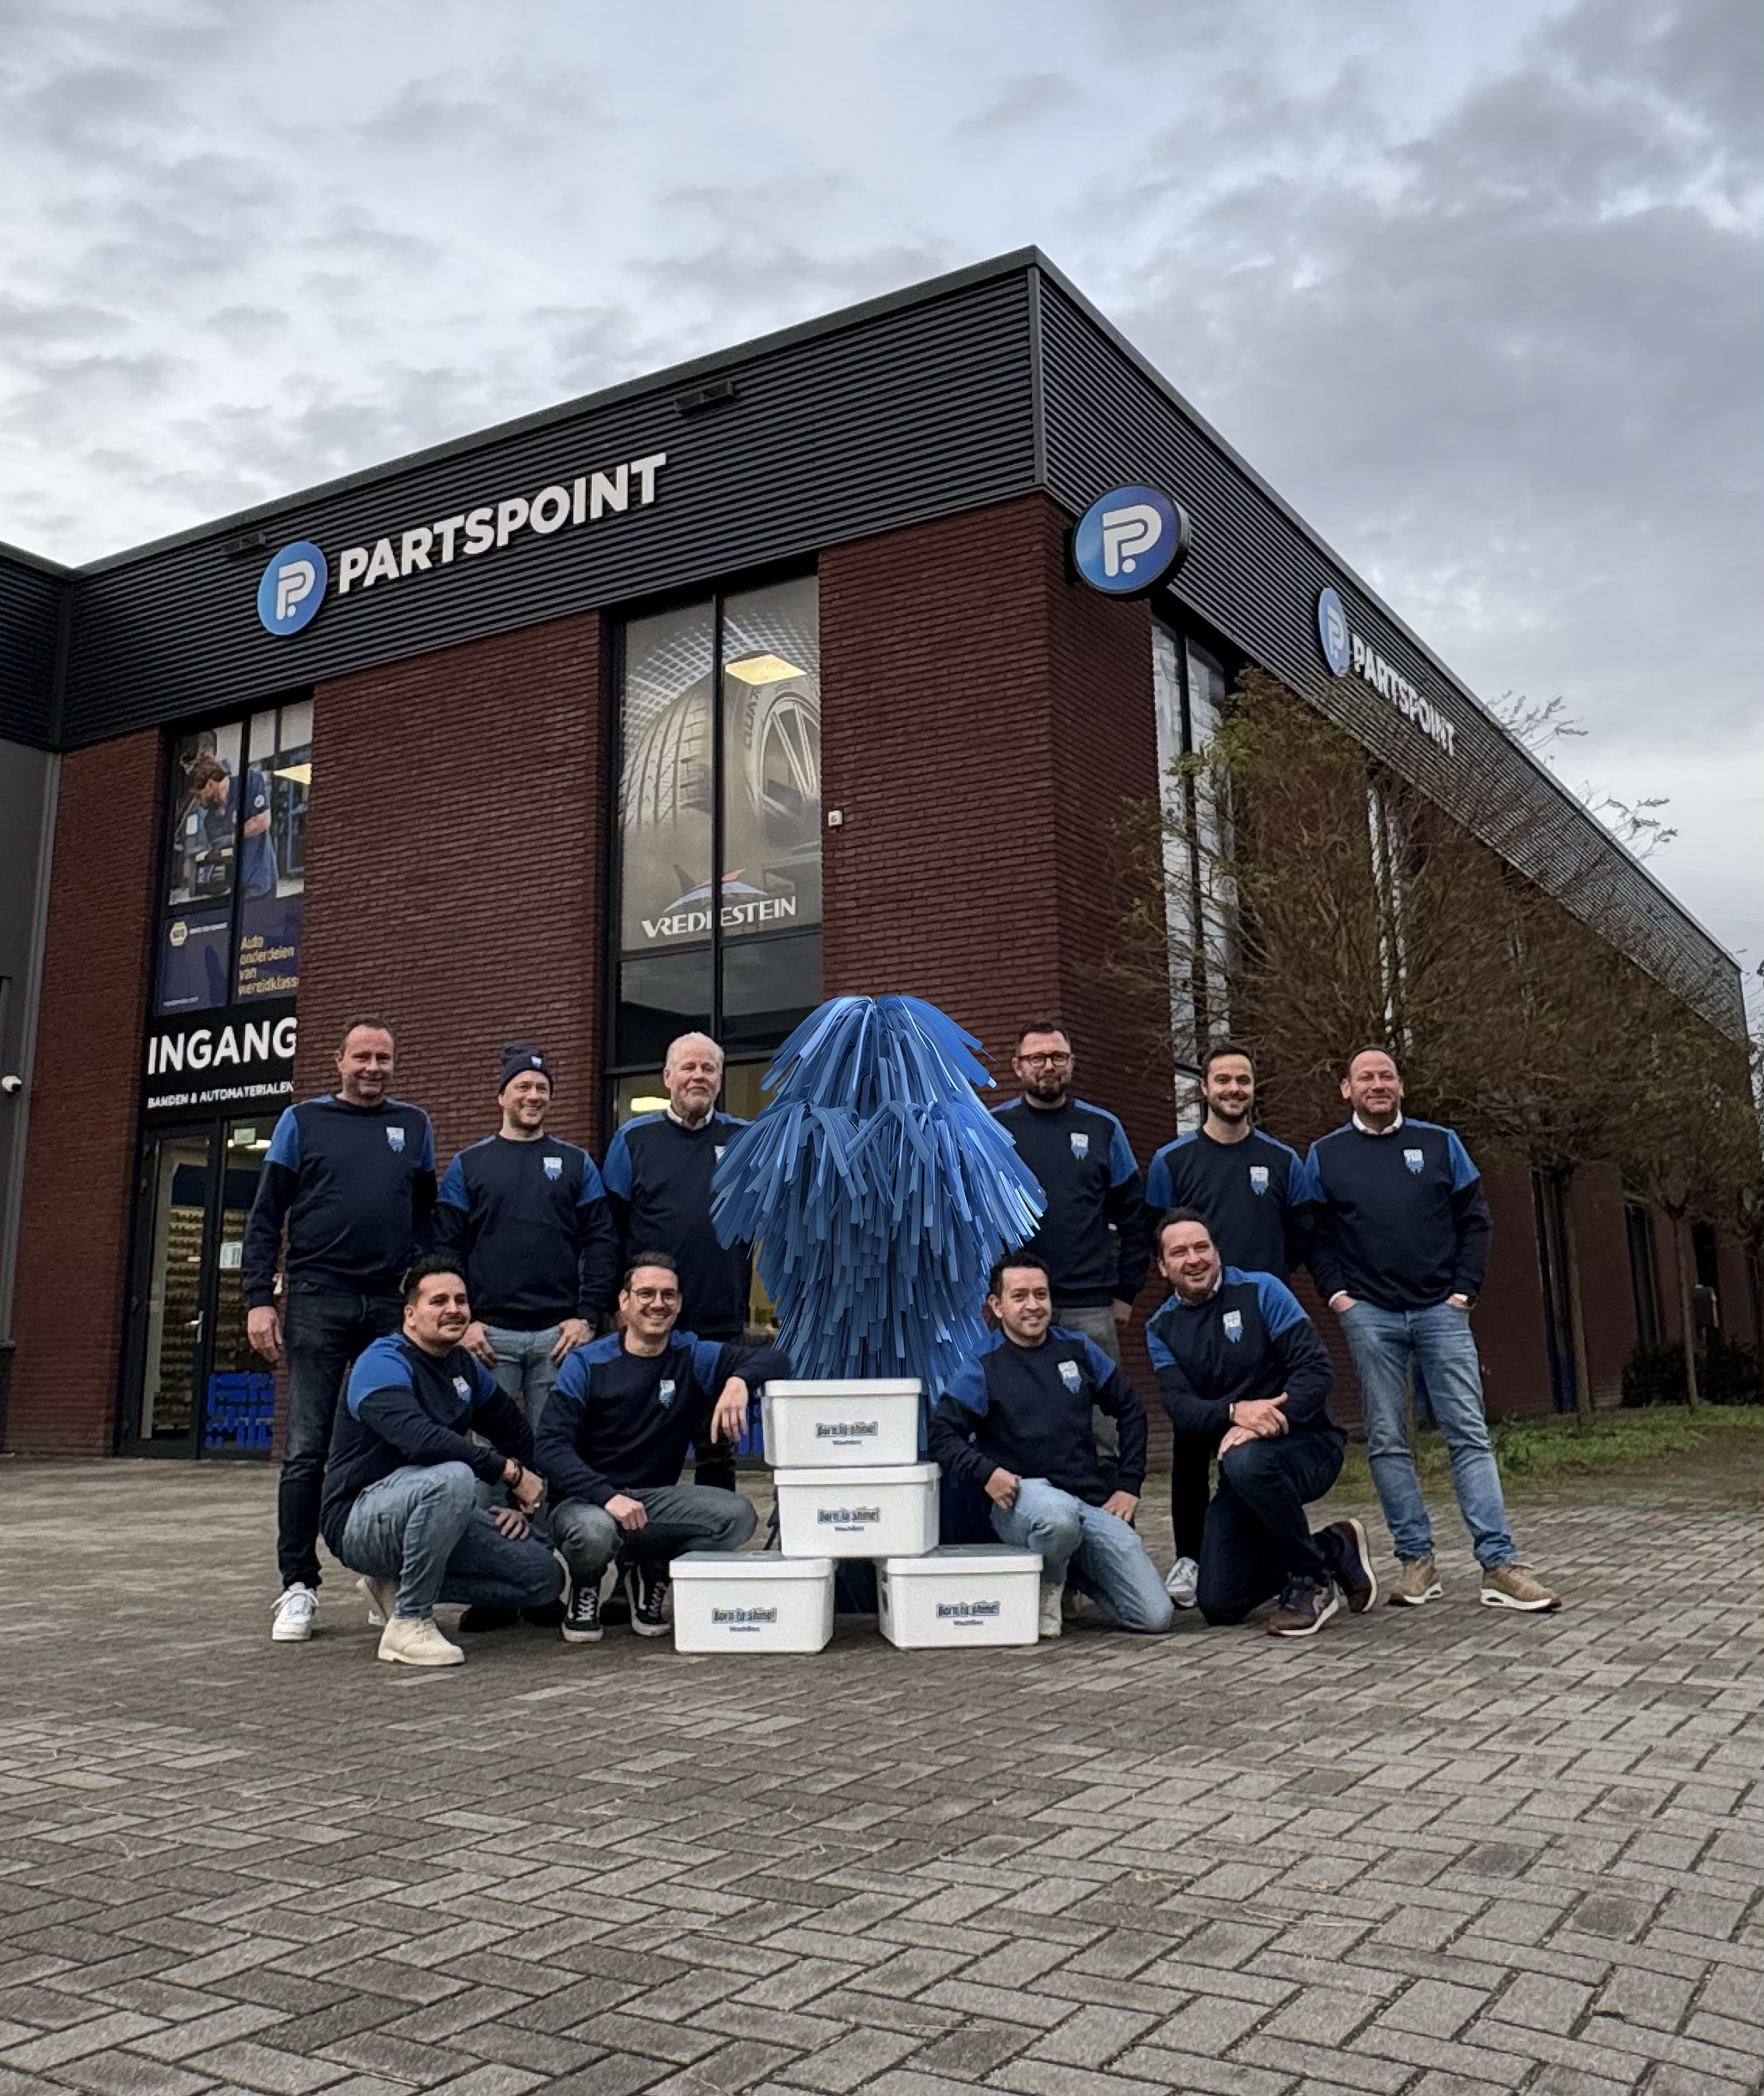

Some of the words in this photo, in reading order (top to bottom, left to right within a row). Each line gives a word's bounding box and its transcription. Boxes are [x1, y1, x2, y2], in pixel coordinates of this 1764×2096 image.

[338, 452, 667, 593] PARTSPOINT
[1352, 632, 1454, 758] PARTSPOINT
[240, 935, 264, 950] Auto
[238, 967, 257, 981] van
[147, 1017, 299, 1076] INGANG
[147, 1093, 189, 1109] BANDEN
